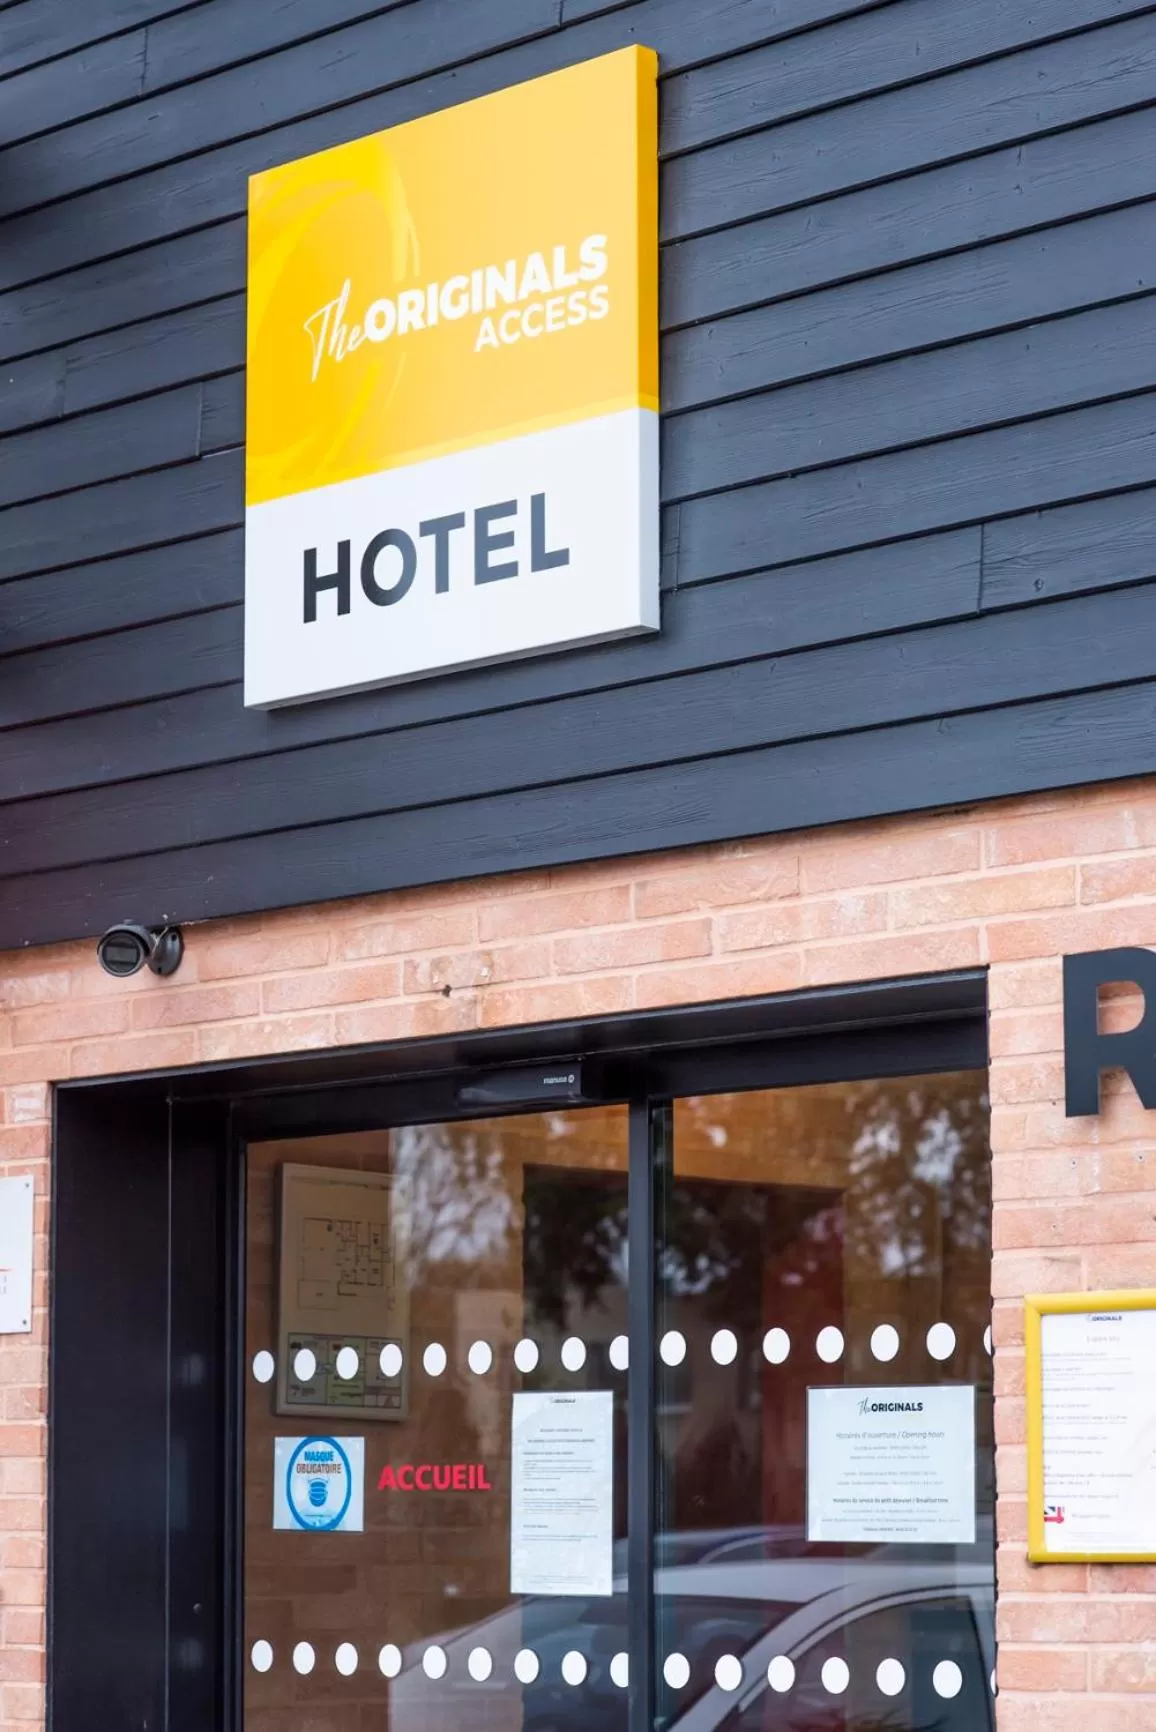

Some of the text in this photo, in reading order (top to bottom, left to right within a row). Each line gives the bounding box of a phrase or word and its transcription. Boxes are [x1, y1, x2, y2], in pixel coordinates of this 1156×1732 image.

[303, 234, 608, 383] The ORIGINALS
[474, 285, 609, 352] ACCESS
[303, 492, 570, 624] HOTEL
[871, 1402, 924, 1412] ORIGINALS
[296, 1463, 342, 1475] OBLIGATOIRE
[304, 1451, 334, 1462] MASQUE
[377, 1464, 492, 1491] ACCUEIL
